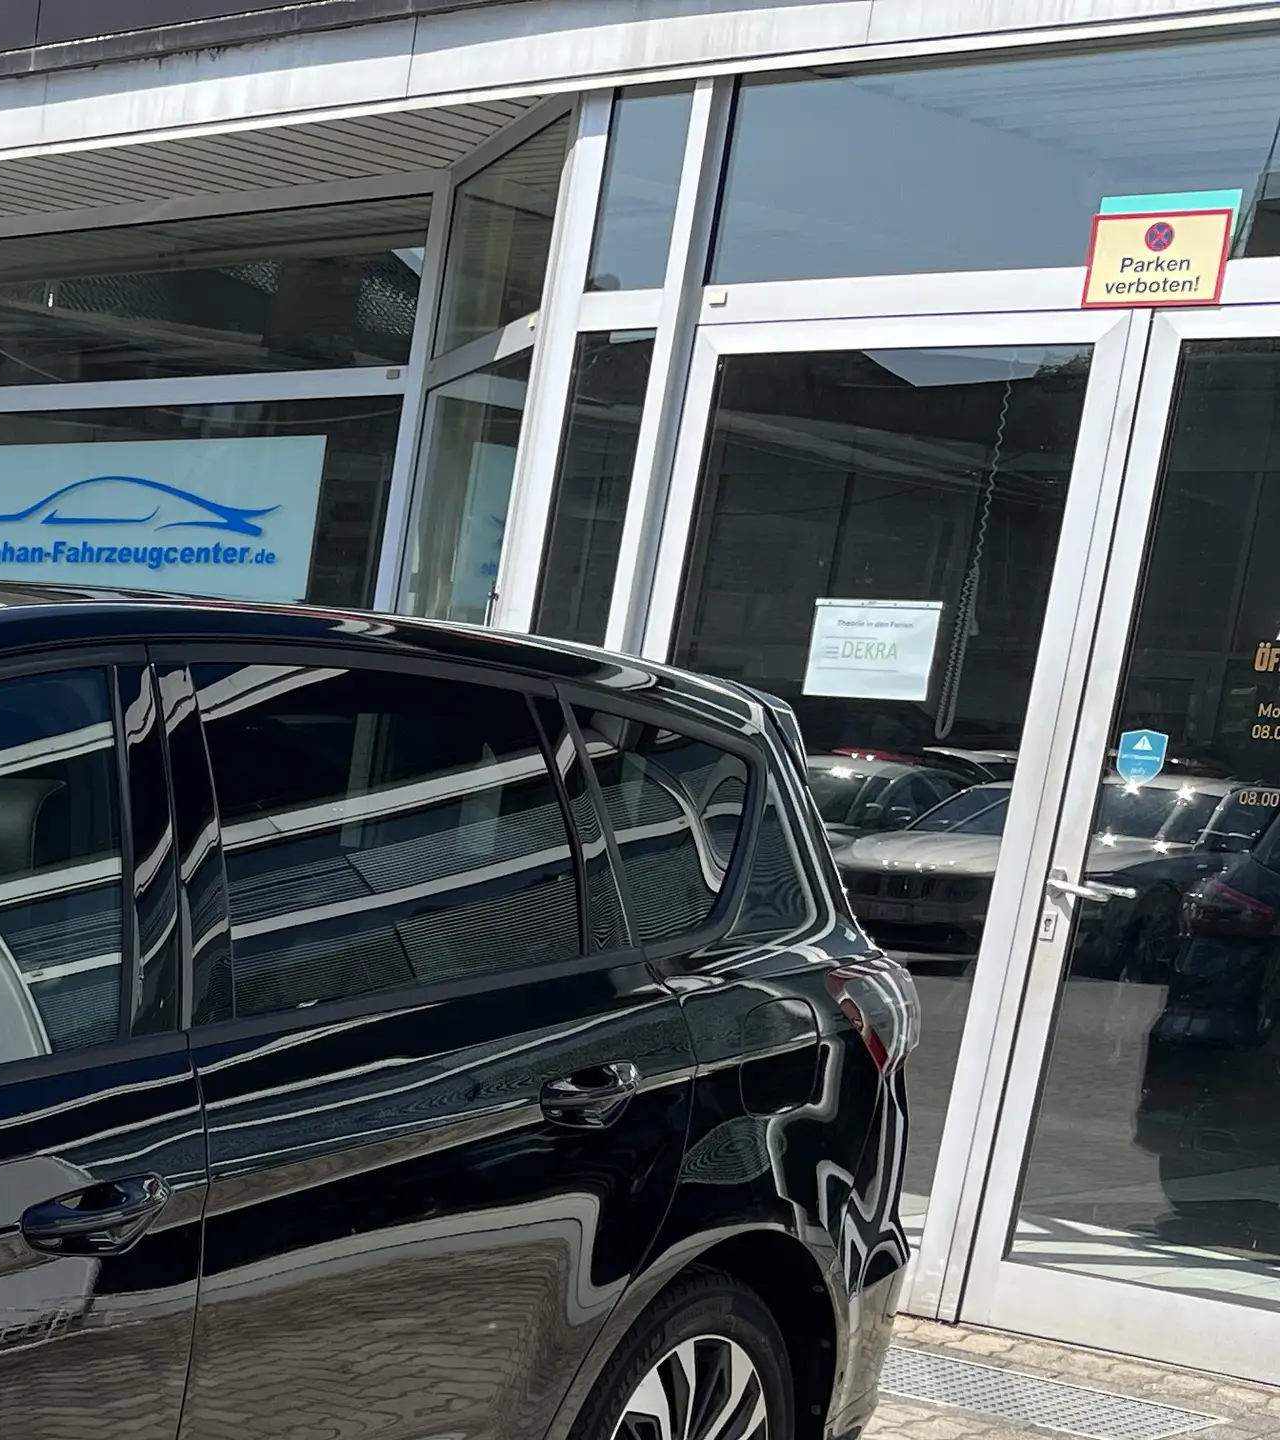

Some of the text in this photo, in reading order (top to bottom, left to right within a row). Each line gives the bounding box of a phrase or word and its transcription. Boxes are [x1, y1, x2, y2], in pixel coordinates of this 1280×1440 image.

[1120, 256, 1191, 273] Parken
[1105, 276, 1201, 294] verboten!
[841, 640, 898, 660] DEKRA
[1254, 642, 1280, 671] ÖF
